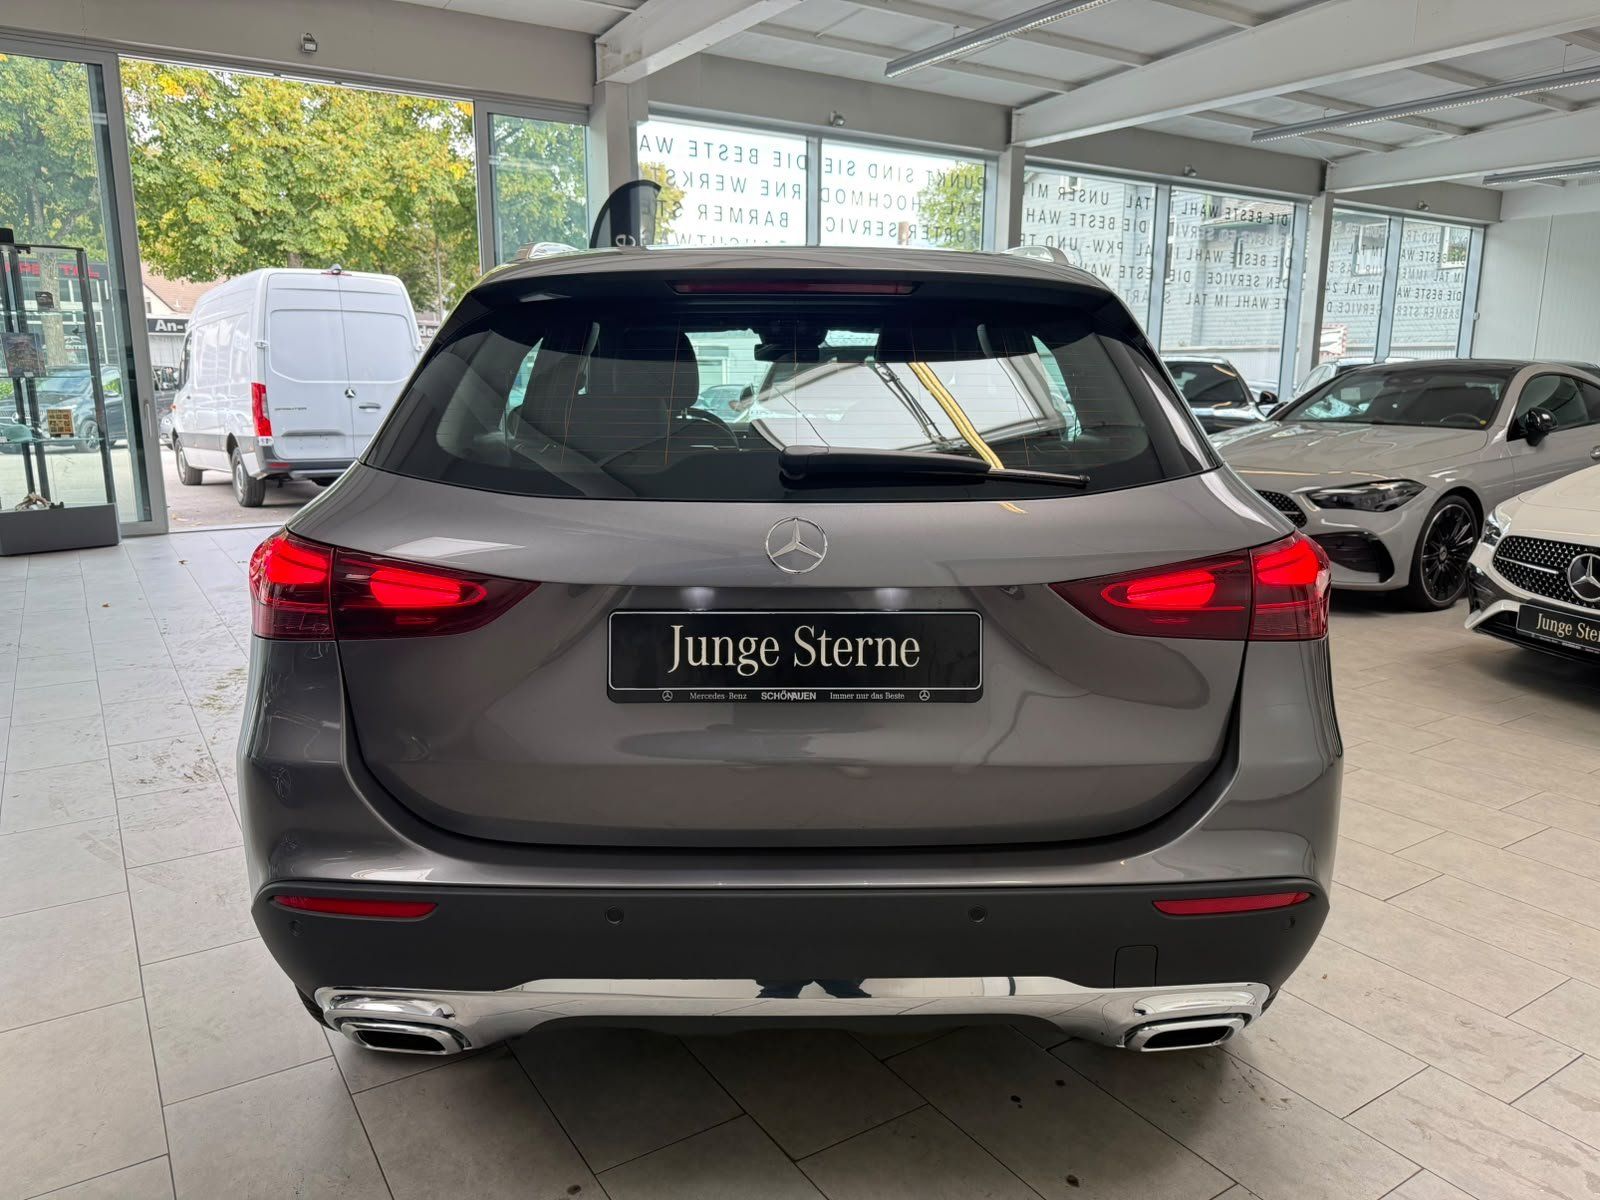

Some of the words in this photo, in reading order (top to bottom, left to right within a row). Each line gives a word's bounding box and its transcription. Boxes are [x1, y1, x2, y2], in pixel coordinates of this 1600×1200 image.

[1536, 613, 1573, 638] Junge
[667, 624, 780, 677] Junge
[793, 624, 921, 668] Sterne
[829, 691, 855, 700] Immer
[870, 691, 884, 700] das
[885, 691, 905, 700] Beste
